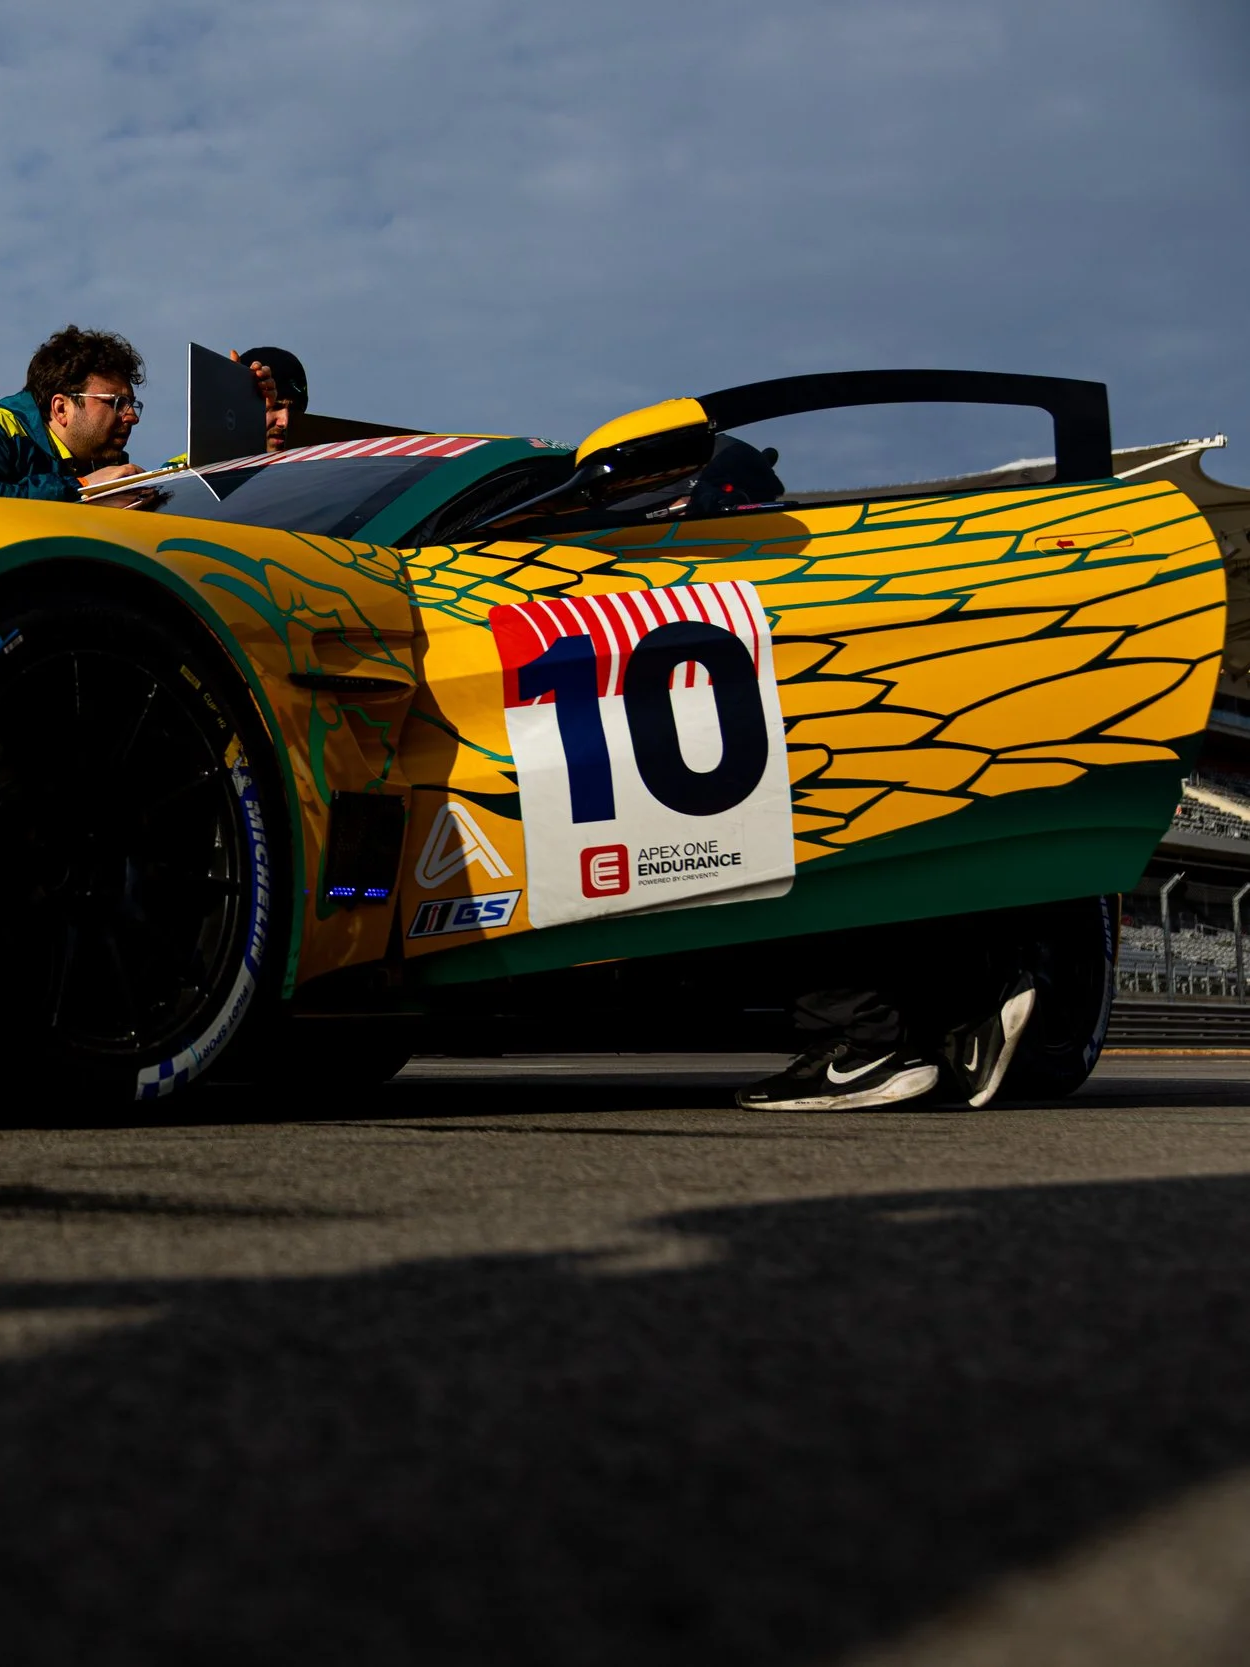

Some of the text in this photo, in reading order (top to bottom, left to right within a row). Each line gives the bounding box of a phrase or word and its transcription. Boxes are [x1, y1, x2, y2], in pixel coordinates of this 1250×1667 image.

[518, 620, 769, 824] 10
[637, 840, 719, 862] APEX ONE
[637, 852, 742, 877] ENDURANCE
[244, 800, 272, 968] MICHELIN
[638, 876, 671, 886] POWERED
[681, 871, 719, 881] CREVENTIC
[198, 985, 250, 1063] PILOT SPORT
